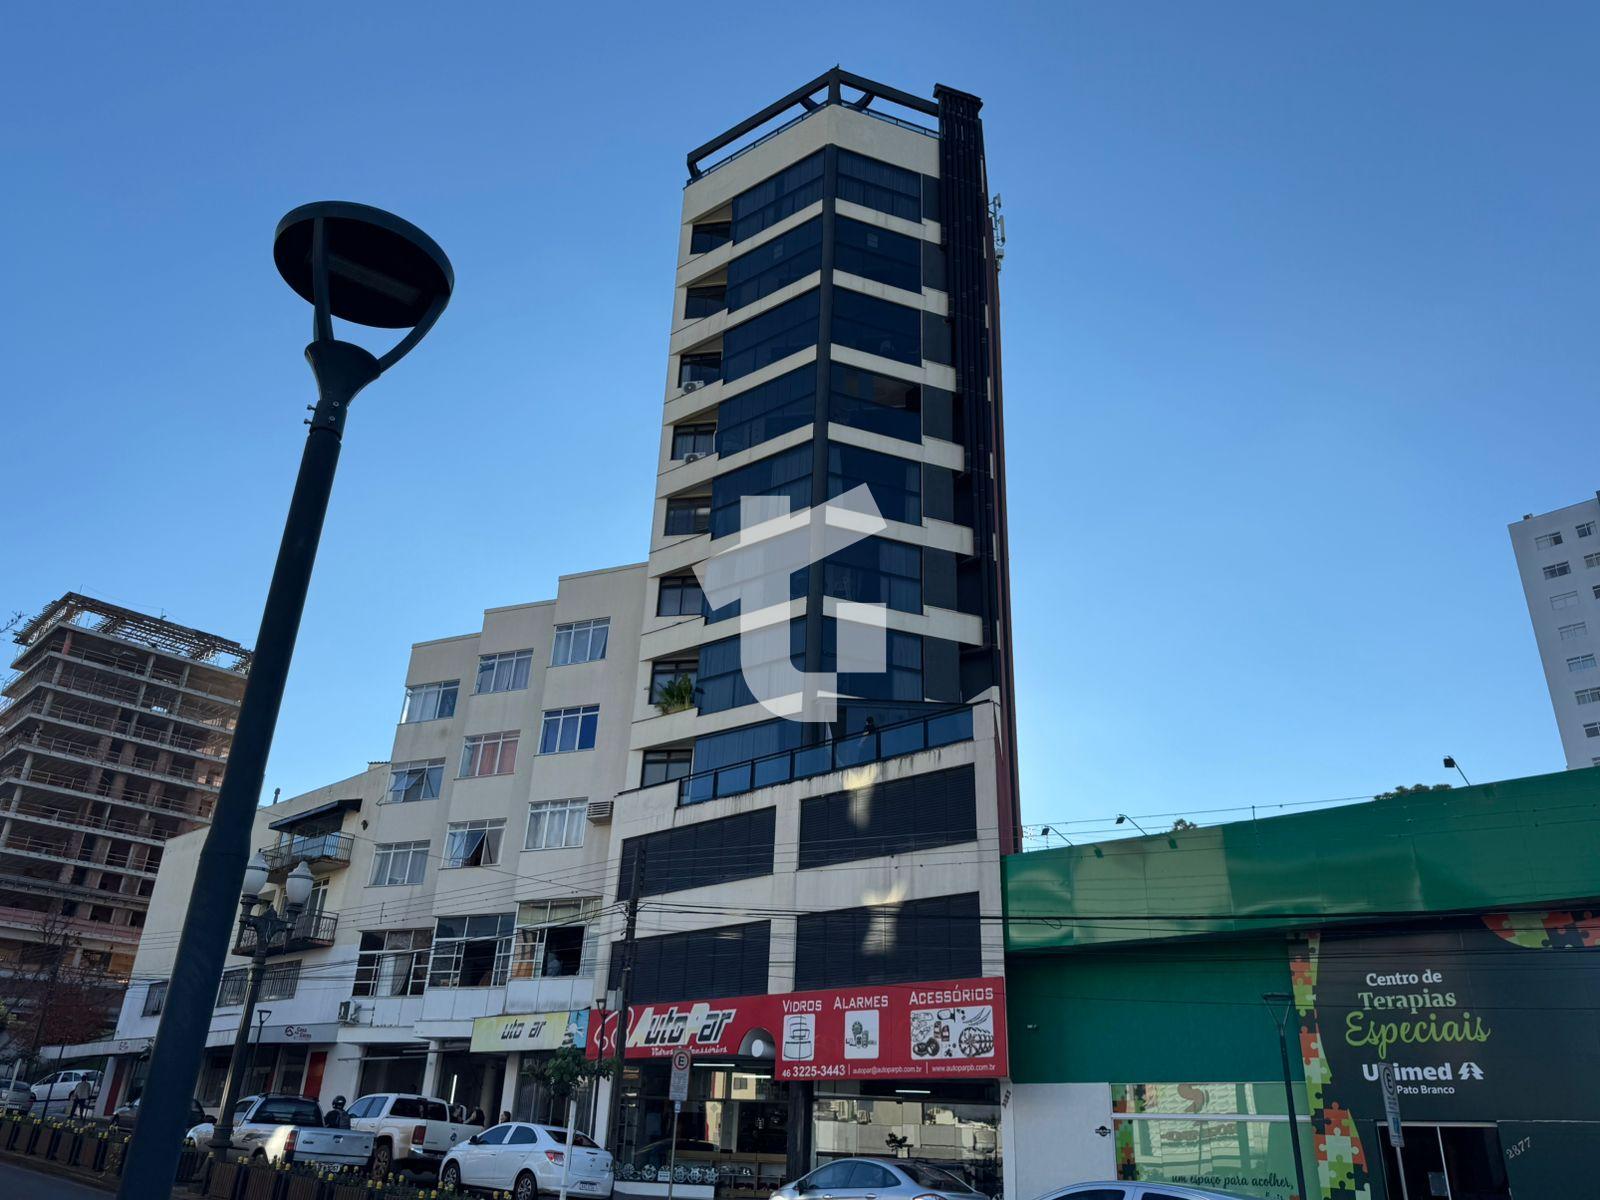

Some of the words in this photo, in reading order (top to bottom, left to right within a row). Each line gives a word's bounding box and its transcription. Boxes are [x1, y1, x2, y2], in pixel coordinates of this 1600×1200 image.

[1366, 973, 1419, 986] Centro
[1421, 969, 1443, 984] de
[833, 996, 889, 1010] ALARMES
[909, 985, 994, 1005] ACESSÓRIOS
[1358, 988, 1457, 1014] Terapias
[782, 1000, 822, 1012] VIDROS
[625, 1003, 737, 1048] AutoPar
[1345, 1011, 1491, 1060] Especiais
[678, 1056, 685, 1066] E
[782, 1069, 791, 1077] 46
[792, 1065, 846, 1078] 3225-3443
[932, 1063, 995, 1073] www.autoparpb.com.br
[1362, 1062, 1453, 1081] Uimed
[1396, 1085, 1419, 1095] Pato
[1421, 1085, 1455, 1095] Branco
[1505, 1136, 1532, 1160] 2877
[1171, 1175, 1187, 1184] um
[1190, 1175, 1221, 1188] espaço
[1223, 1175, 1249, 1189] para
